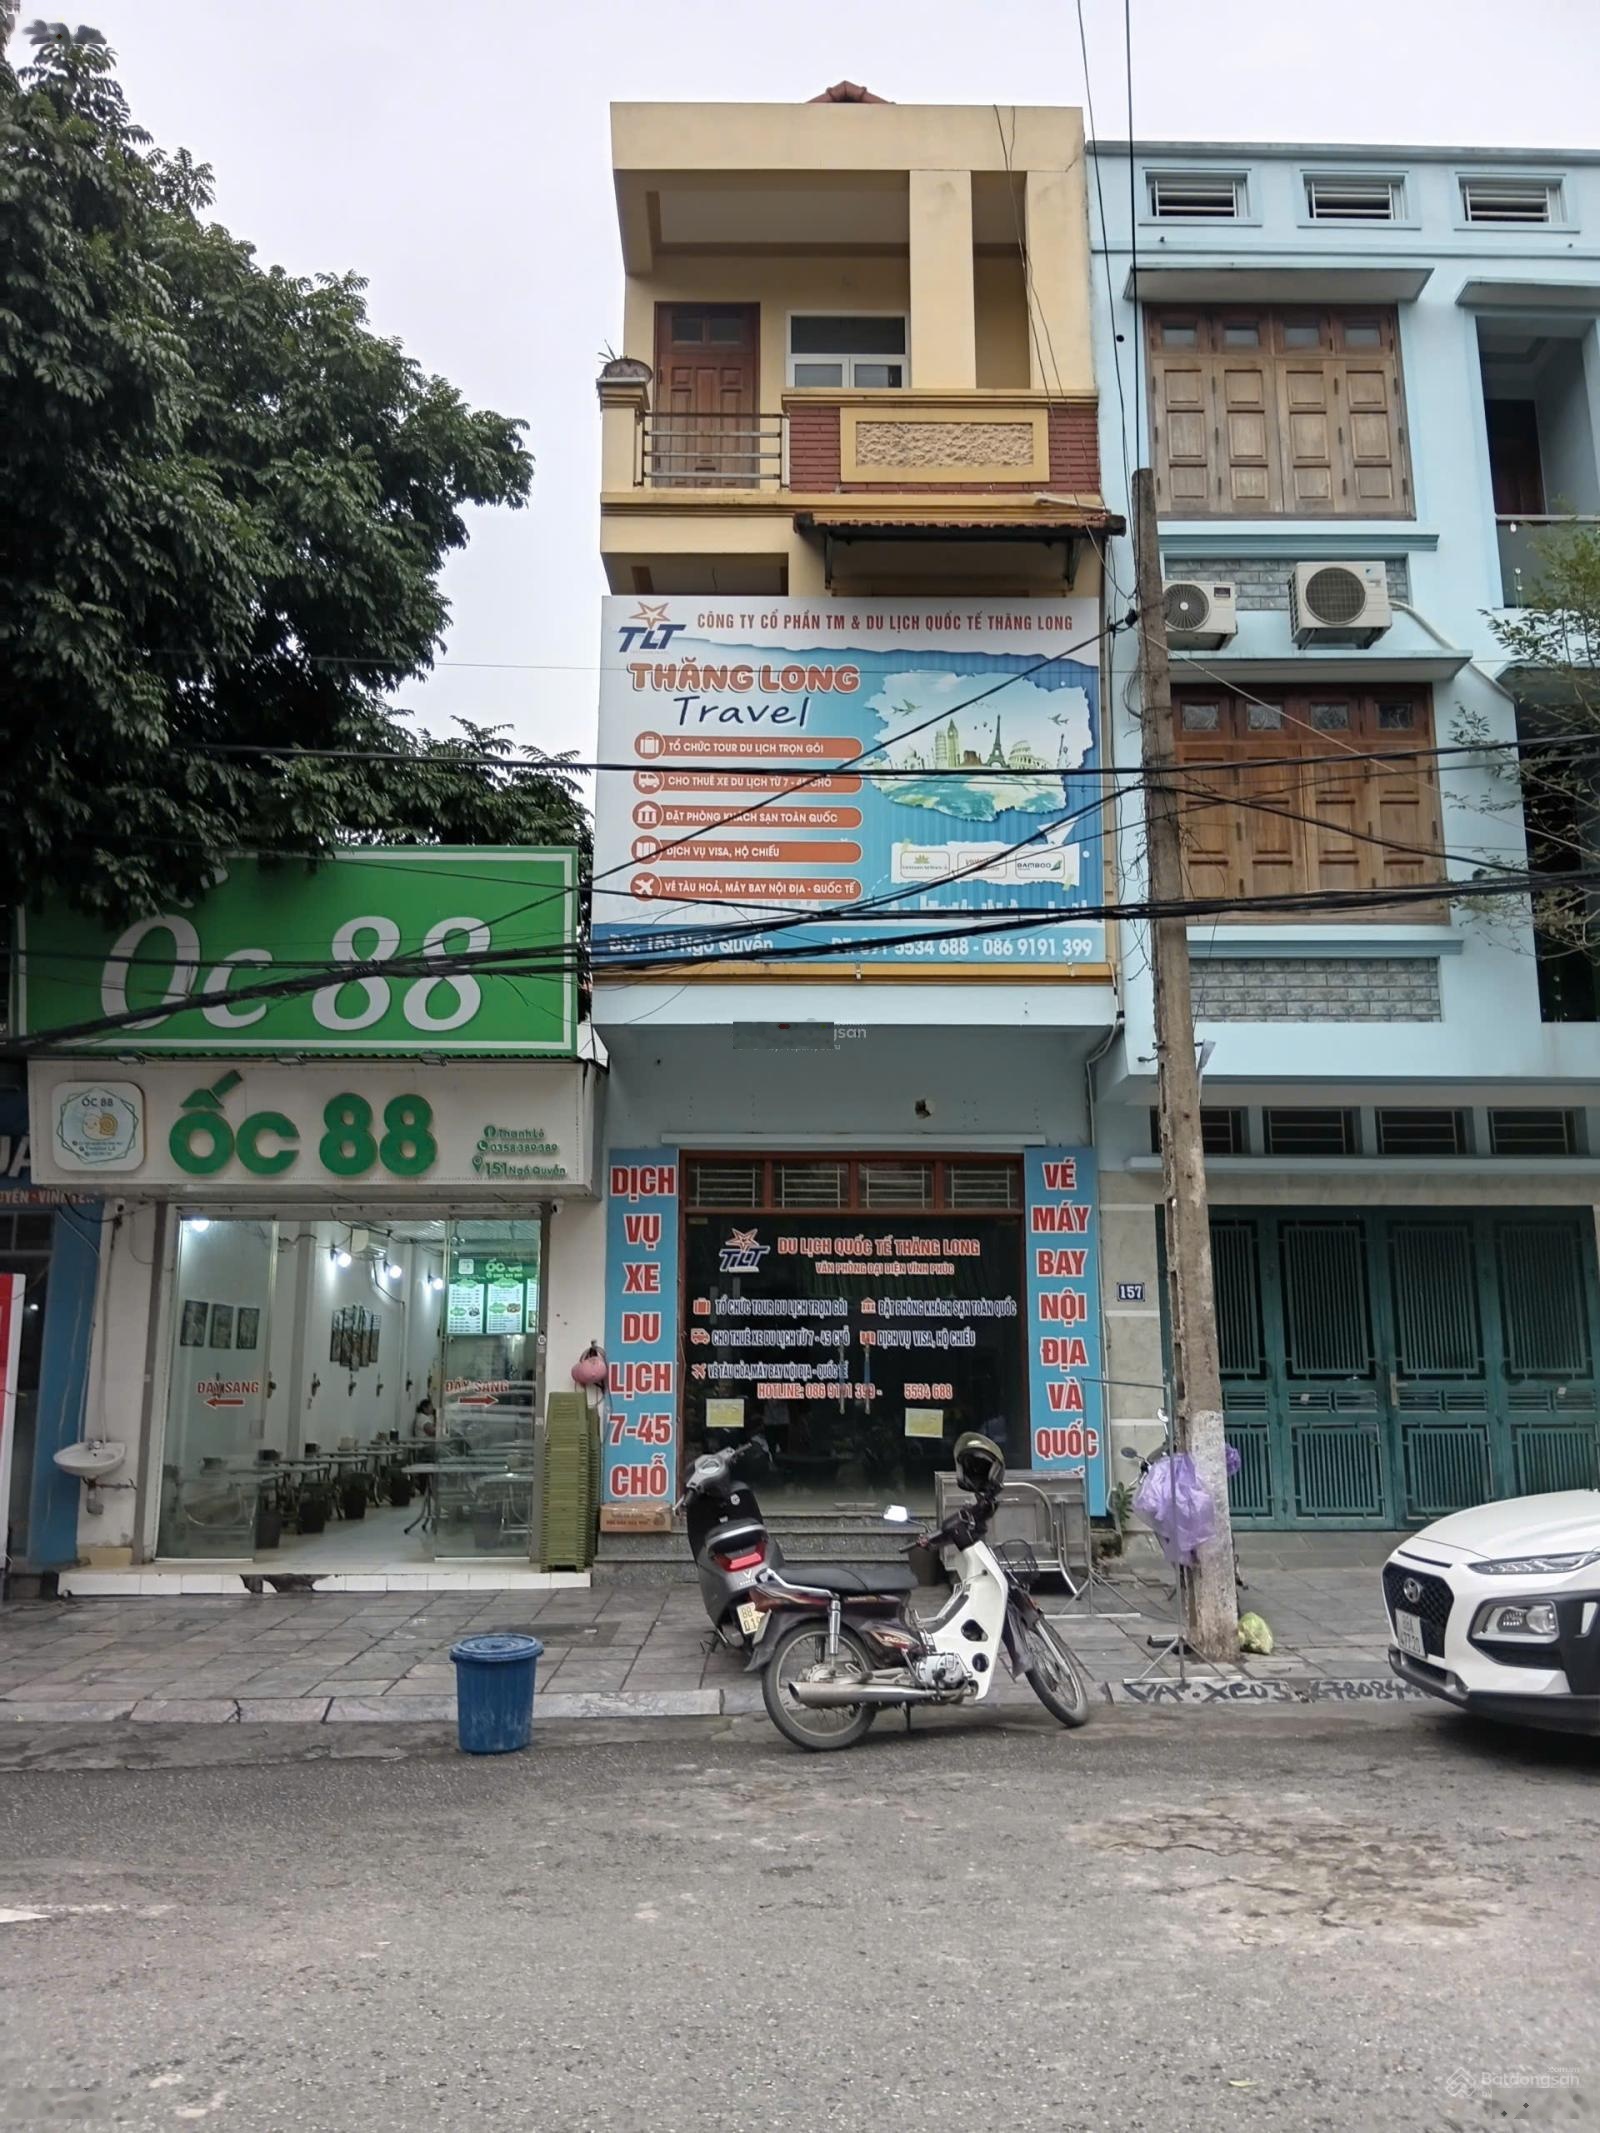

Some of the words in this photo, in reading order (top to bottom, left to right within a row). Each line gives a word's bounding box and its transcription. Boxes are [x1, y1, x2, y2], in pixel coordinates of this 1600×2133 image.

[697, 610, 734, 629] CÔNG
[740, 614, 754, 629] TY
[761, 609, 779, 629] CỔ
[826, 615, 845, 630] TM
[851, 616, 860, 631] &
[866, 615, 884, 631] DU
[889, 615, 920, 634] LỊCH
[925, 610, 961, 632] QUỐC
[967, 610, 982, 631] TẾ
[1037, 616, 1073, 631] LONG
[618, 624, 687, 653] TLT
[627, 657, 753, 692] THĂNG
[758, 664, 859, 694] LONG
[673, 695, 810, 727] Travel
[668, 739, 681, 752] TỔ
[713, 743, 737, 752] TOUR
[740, 744, 752, 752] DU
[755, 744, 776, 755] LỊCH
[779, 744, 803, 755] TRỌN
[806, 743, 824, 753] GÓI
[668, 776, 690, 785] CHO
[692, 775, 715, 786] THUÊ
[716, 777, 729, 786] XE
[731, 778, 744, 786] DU
[746, 778, 768, 789] LỊCH
[783, 778, 789, 787] 7
[666, 812, 684, 824] ĐẶT
[687, 811, 721, 821] PHÒNG
[760, 813, 779, 825] SẠN
[781, 811, 807, 822] TOÀN
[809, 810, 837, 823] QUỐC
[693, 847, 706, 859] VỤ
[734, 847, 750, 859] HỘ
[752, 844, 779, 857] CHIẾU
[665, 880, 676, 892] VÉ
[678, 880, 696, 892] TÀU
[725, 880, 746, 892] MÁY
[749, 883, 767, 892] BAY
[769, 881, 786, 895] NỘI
[788, 884, 805, 895] ĐỊA
[813, 880, 842, 893] QUỐC
[845, 880, 855, 893] TẾ
[939, 938, 969, 956] 688
[983, 938, 1013, 956] 086
[1017, 938, 1056, 956] 9191
[1063, 938, 1092, 957] 399
[311, 916, 491, 1031] 88
[319, 1092, 437, 1177] 88
[611, 1166, 676, 1202] DỊCH
[1042, 1157, 1077, 1190] VÉ
[1031, 1200, 1092, 1233] MÁY
[624, 1213, 661, 1250] VỤ
[778, 1237, 798, 1255] DU
[800, 1237, 831, 1257] LỊCH
[834, 1234, 872, 1256] QUỐC
[875, 1234, 893, 1256] TẾ
[895, 1236, 940, 1256] THĂNG
[943, 1239, 980, 1257] LONG
[1036, 1249, 1088, 1277] BAY
[623, 1263, 660, 1293] XE
[1120, 1285, 1142, 1299] 157
[751, 1300, 774, 1315] TOUR
[775, 1300, 788, 1315] DU
[789, 1300, 808, 1319] LỊCH
[808, 1300, 832, 1319] TRỌN
[895, 1297, 923, 1316] PHÒNG
[924, 1297, 952, 1316] KHÁCH
[953, 1300, 971, 1319] SẠN
[971, 1297, 993, 1316] TOÀN
[993, 1295, 1017, 1318] QUỐC
[1039, 1287, 1087, 1327] NỘI
[622, 1312, 660, 1343] DU
[712, 1330, 730, 1346] CHO
[730, 1326, 751, 1346] THUÊ
[751, 1330, 763, 1346] XE
[764, 1330, 777, 1346] DU
[777, 1330, 796, 1349] LỊCH
[820, 1330, 832, 1346] 45
[877, 1330, 898, 1349] DỊCH
[899, 1330, 911, 1349] VỤ
[936, 1328, 950, 1350] HỘ
[950, 1326, 976, 1347] CHIẾU
[1041, 1337, 1089, 1372] ĐỊA
[609, 1362, 672, 1399] LỊCH
[769, 1364, 784, 1378] BAY
[225, 1381, 260, 1393] SANG
[473, 1380, 509, 1393] SANG
[757, 1383, 804, 1399] HOTLINE:
[805, 1383, 826, 1399] 086
[904, 1383, 931, 1399] 5534
[932, 1383, 953, 1399] 688
[1047, 1377, 1084, 1411] VÀ
[609, 1413, 671, 1447] 7-45
[1035, 1419, 1099, 1460] QUỐC
[610, 1453, 668, 1498] CHỖ
